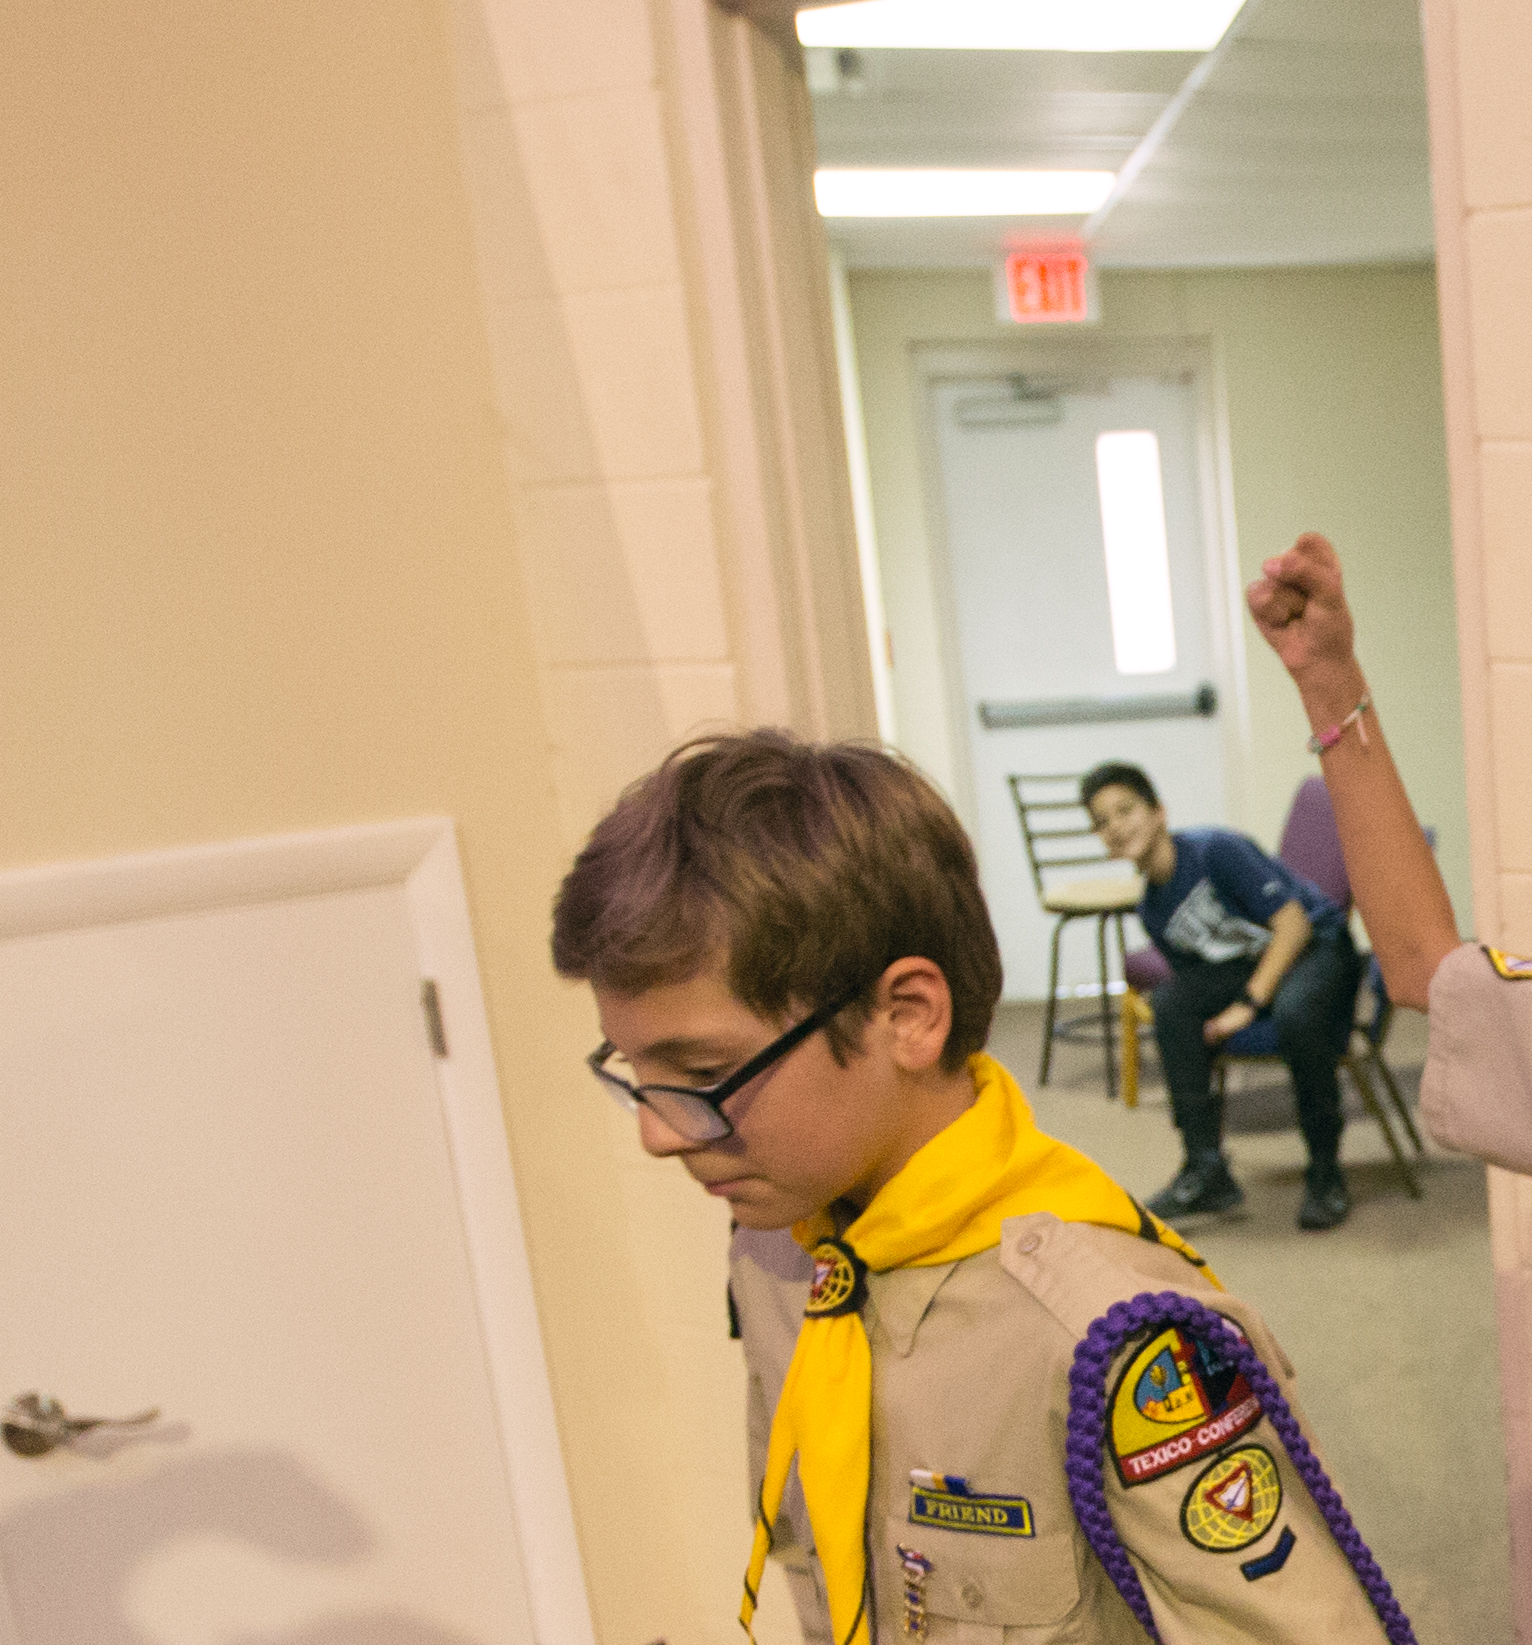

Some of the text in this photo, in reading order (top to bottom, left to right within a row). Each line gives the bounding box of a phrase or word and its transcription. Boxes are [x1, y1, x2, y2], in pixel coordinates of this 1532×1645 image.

[1013, 258, 1082, 315] EXIT
[1128, 1436, 1192, 1475] TEXICO
[925, 1500, 1008, 1525] FRIEND
